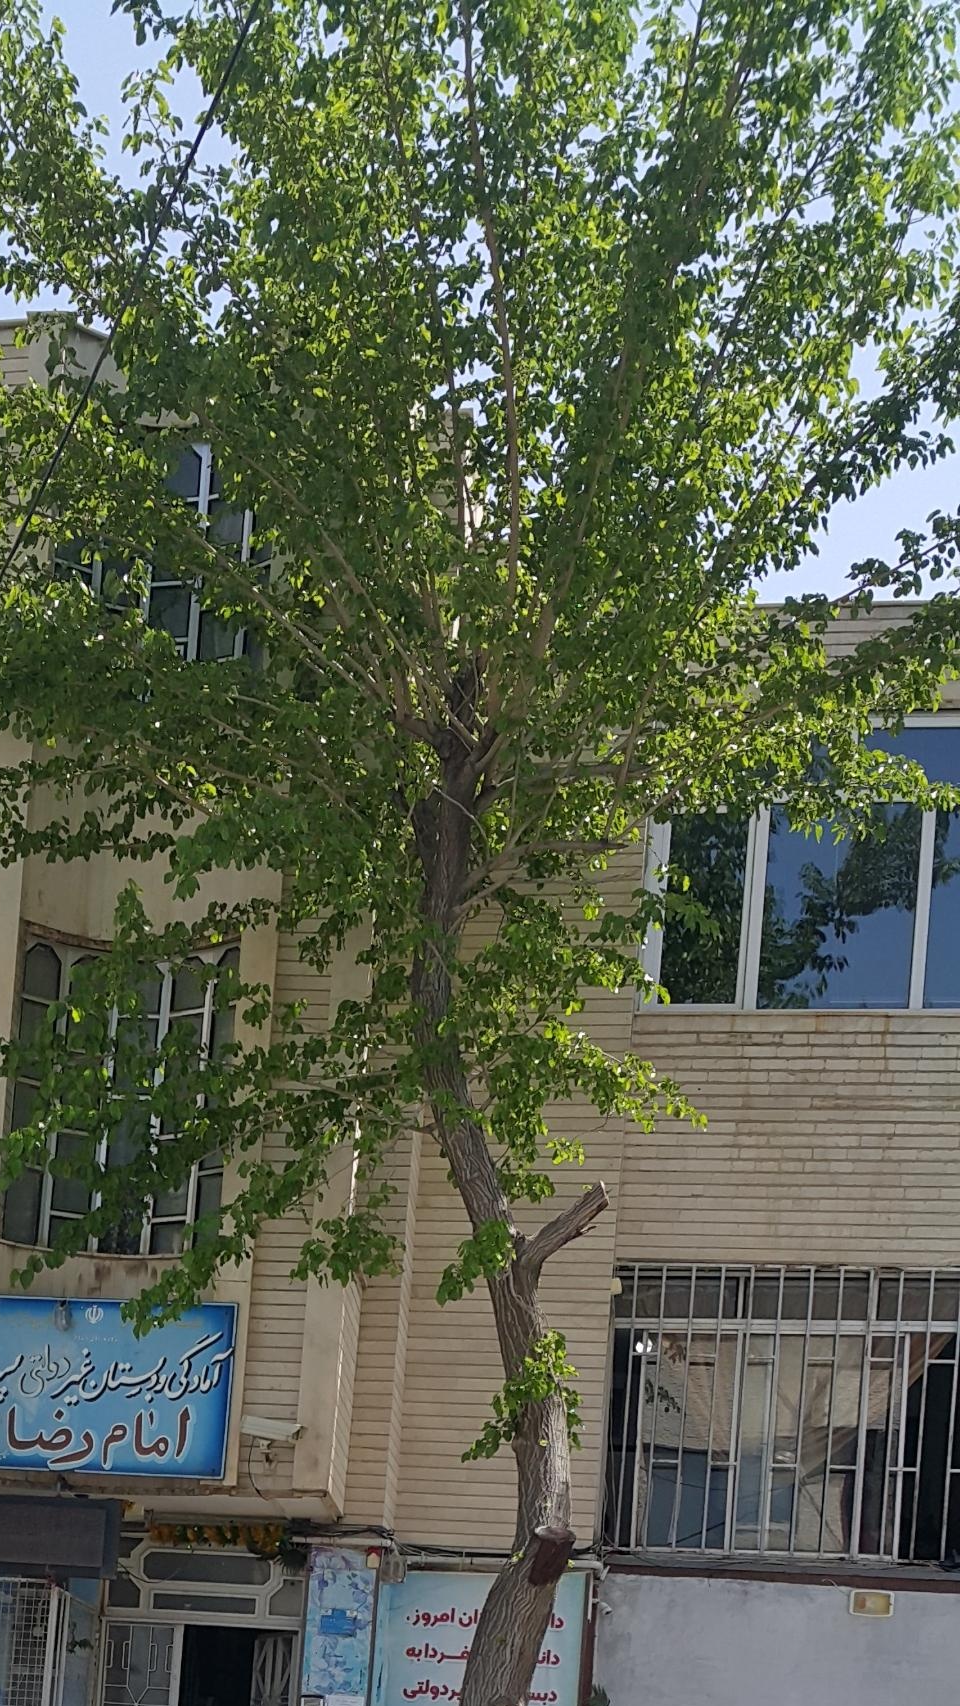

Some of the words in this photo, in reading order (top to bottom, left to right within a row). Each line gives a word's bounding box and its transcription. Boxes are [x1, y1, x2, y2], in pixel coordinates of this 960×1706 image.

[18, 1343, 72, 1399] دولتی
[50, 1346, 96, 1406] غیر
[77, 1355, 167, 1404] دبستان
[164, 1330, 234, 1401] آمادگی
[7, 1403, 95, 1471] رضا
[101, 1404, 192, 1471] امام
